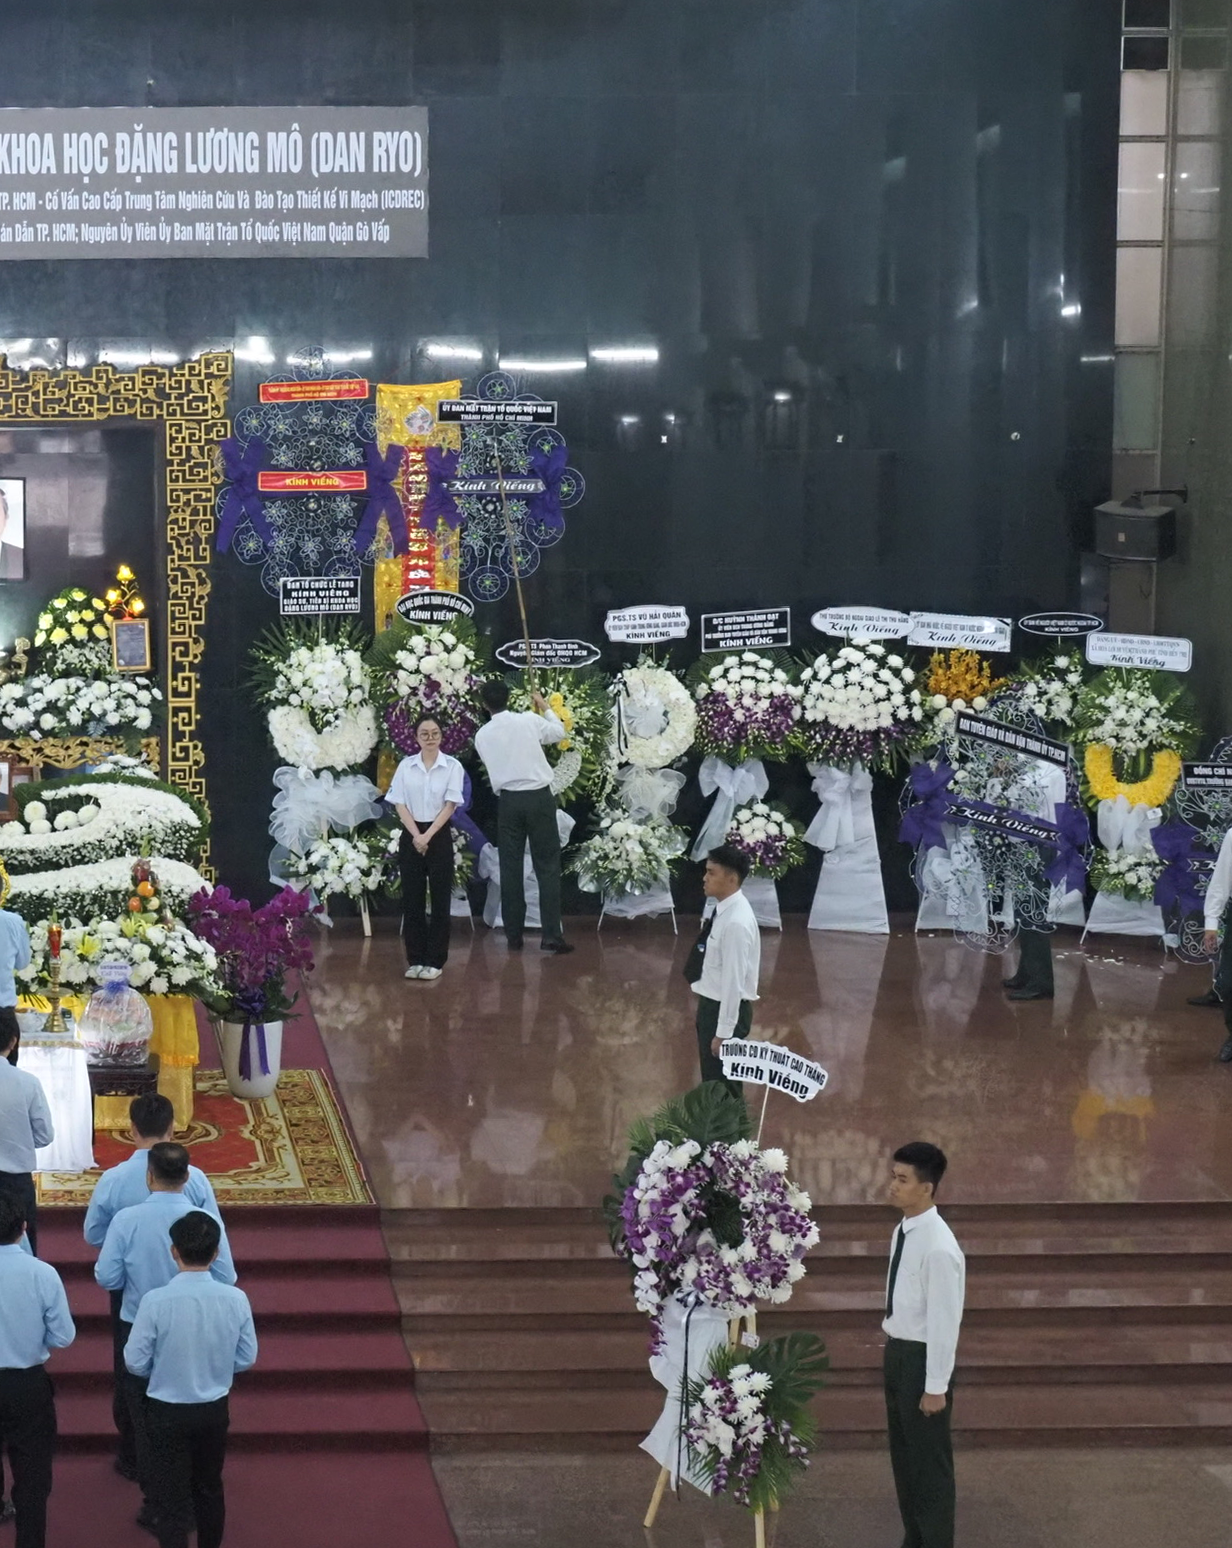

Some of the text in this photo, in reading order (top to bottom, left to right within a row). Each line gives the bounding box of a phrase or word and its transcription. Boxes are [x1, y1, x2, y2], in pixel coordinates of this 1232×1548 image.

[63, 132, 108, 183] HỌC
[115, 123, 178, 183] ĐẶNG
[185, 128, 259, 174] LƯƠNG
[267, 123, 303, 173] MÔ
[311, 131, 365, 177] (DAN
[373, 131, 422, 177] RYO)
[13, 192, 36, 210] HCM
[45, 189, 60, 210] Cố
[61, 188, 80, 210] Vấn
[82, 191, 101, 210] Cao
[103, 187, 123, 212] Cấp
[124, 190, 152, 211] Trung
[155, 190, 175, 210] Tâm
[178, 190, 213, 212] Nghiên
[216, 190, 235, 209] Cứu
[237, 190, 250, 209] Và
[255, 190, 274, 209] Đào
[276, 190, 294, 212] Tạo
[296, 187, 321, 209] Thiết
[323, 187, 337, 209] Kế
[339, 190, 348, 209] Vi
[351, 189, 378, 212] Mạch
[381, 189, 425, 210] (ICDREC)
[15, 220, 34, 242] Dẫn
[36, 223, 50, 242] TP.
[52, 223, 78, 244] HCM;
[81, 223, 118, 243] Nguyên
[120, 217, 133, 243] Ủy
[135, 222, 157, 242] Viên
[159, 217, 171, 243] Ủy
[174, 222, 193, 241] Ban
[195, 222, 215, 245] Mặt
[217, 222, 238, 245] Trận
[240, 218, 252, 241] Tổ
[254, 219, 280, 242] Quốc
[282, 222, 301, 245] Việt
[303, 222, 326, 241] Nam
[328, 221, 354, 245] Quận
[356, 221, 369, 241] Gò
[371, 218, 390, 243] Vấp
[410, 609, 431, 619] KÍNH
[626, 629, 670, 639] KÍNH VIẾNG
[720, 635, 773, 647] KÍNH VIẾNG
[928, 630, 956, 642] Kính
[959, 806, 998, 825] Kính
[722, 1042, 747, 1056] TRƯỜNG
[770, 1050, 790, 1067] THUẬT
[790, 1057, 804, 1073] CAO
[730, 1062, 809, 1099] Kính Viếng
